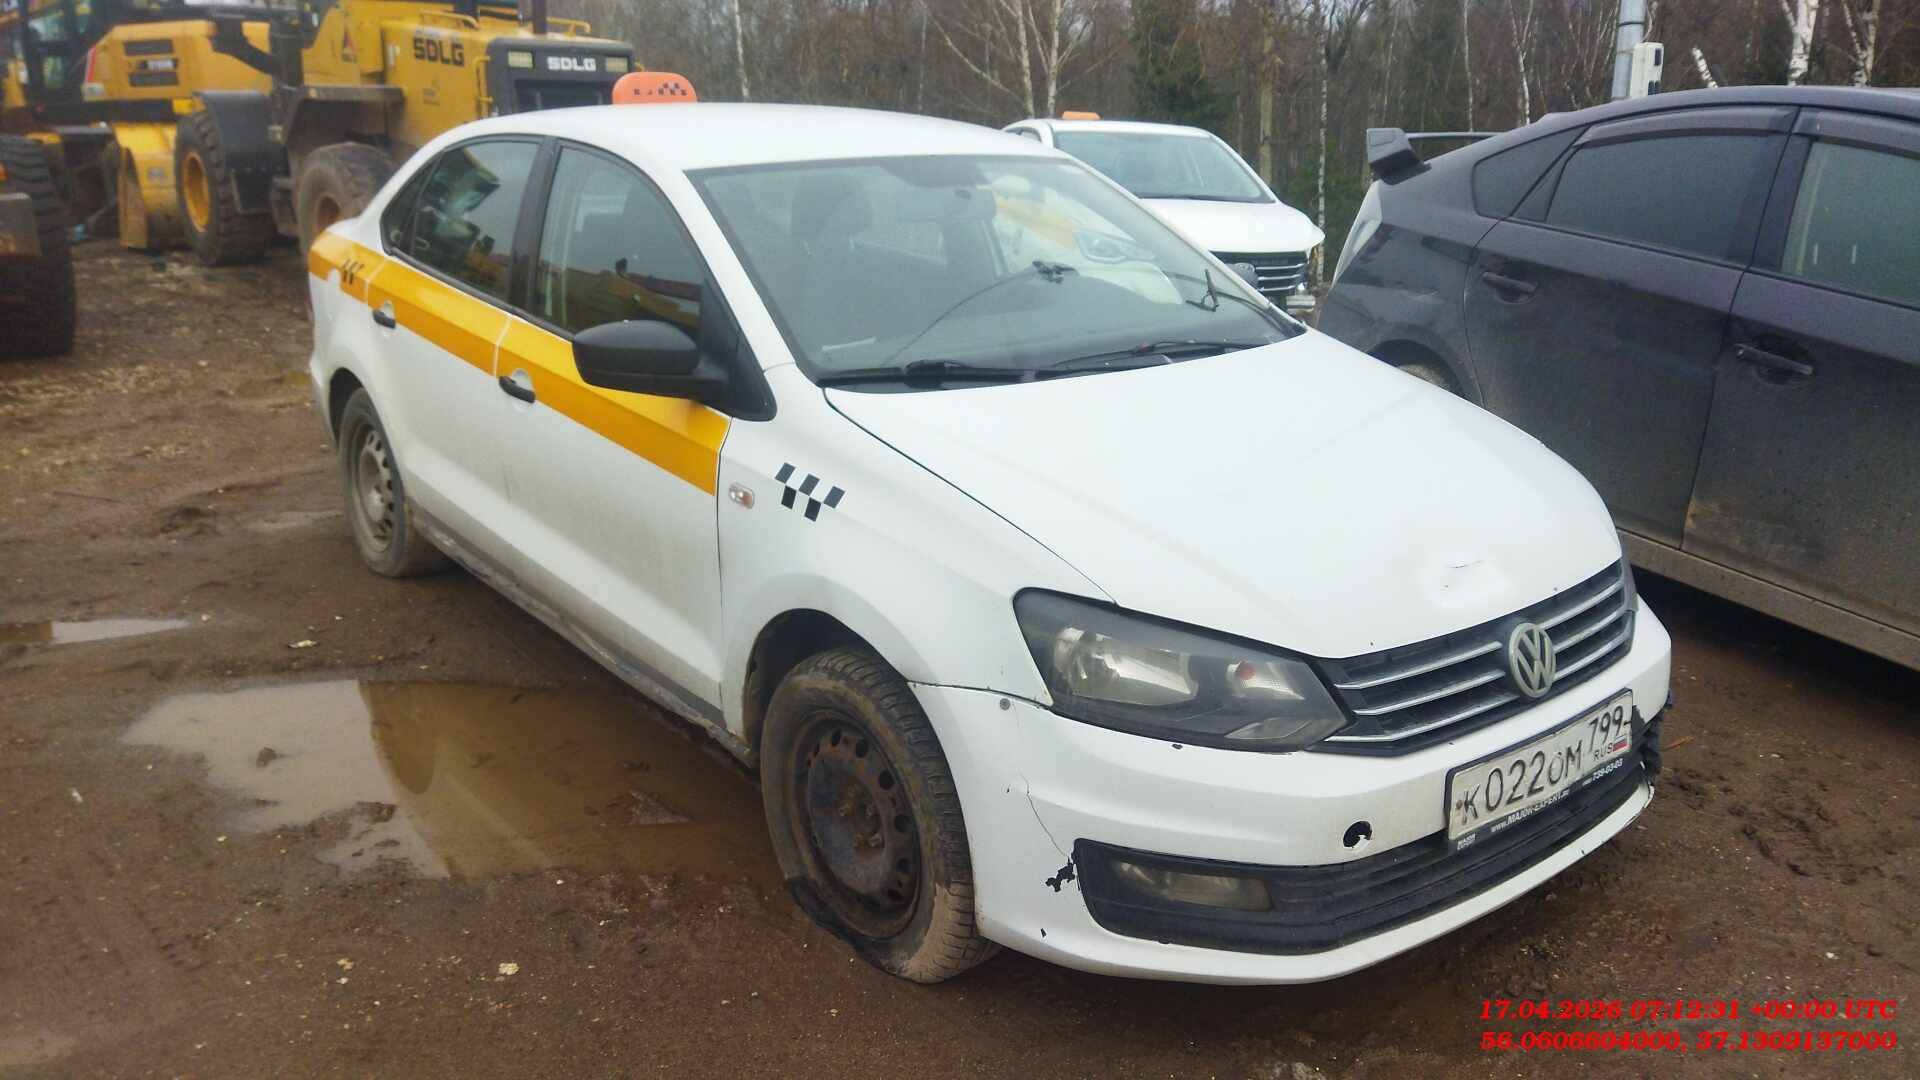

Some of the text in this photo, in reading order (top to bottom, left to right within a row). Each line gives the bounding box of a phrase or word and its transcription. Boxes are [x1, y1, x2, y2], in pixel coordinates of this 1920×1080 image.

[413, 36, 465, 67] SDLG
[547, 56, 597, 71] SDLG
[1593, 742, 1614, 761] RUS
